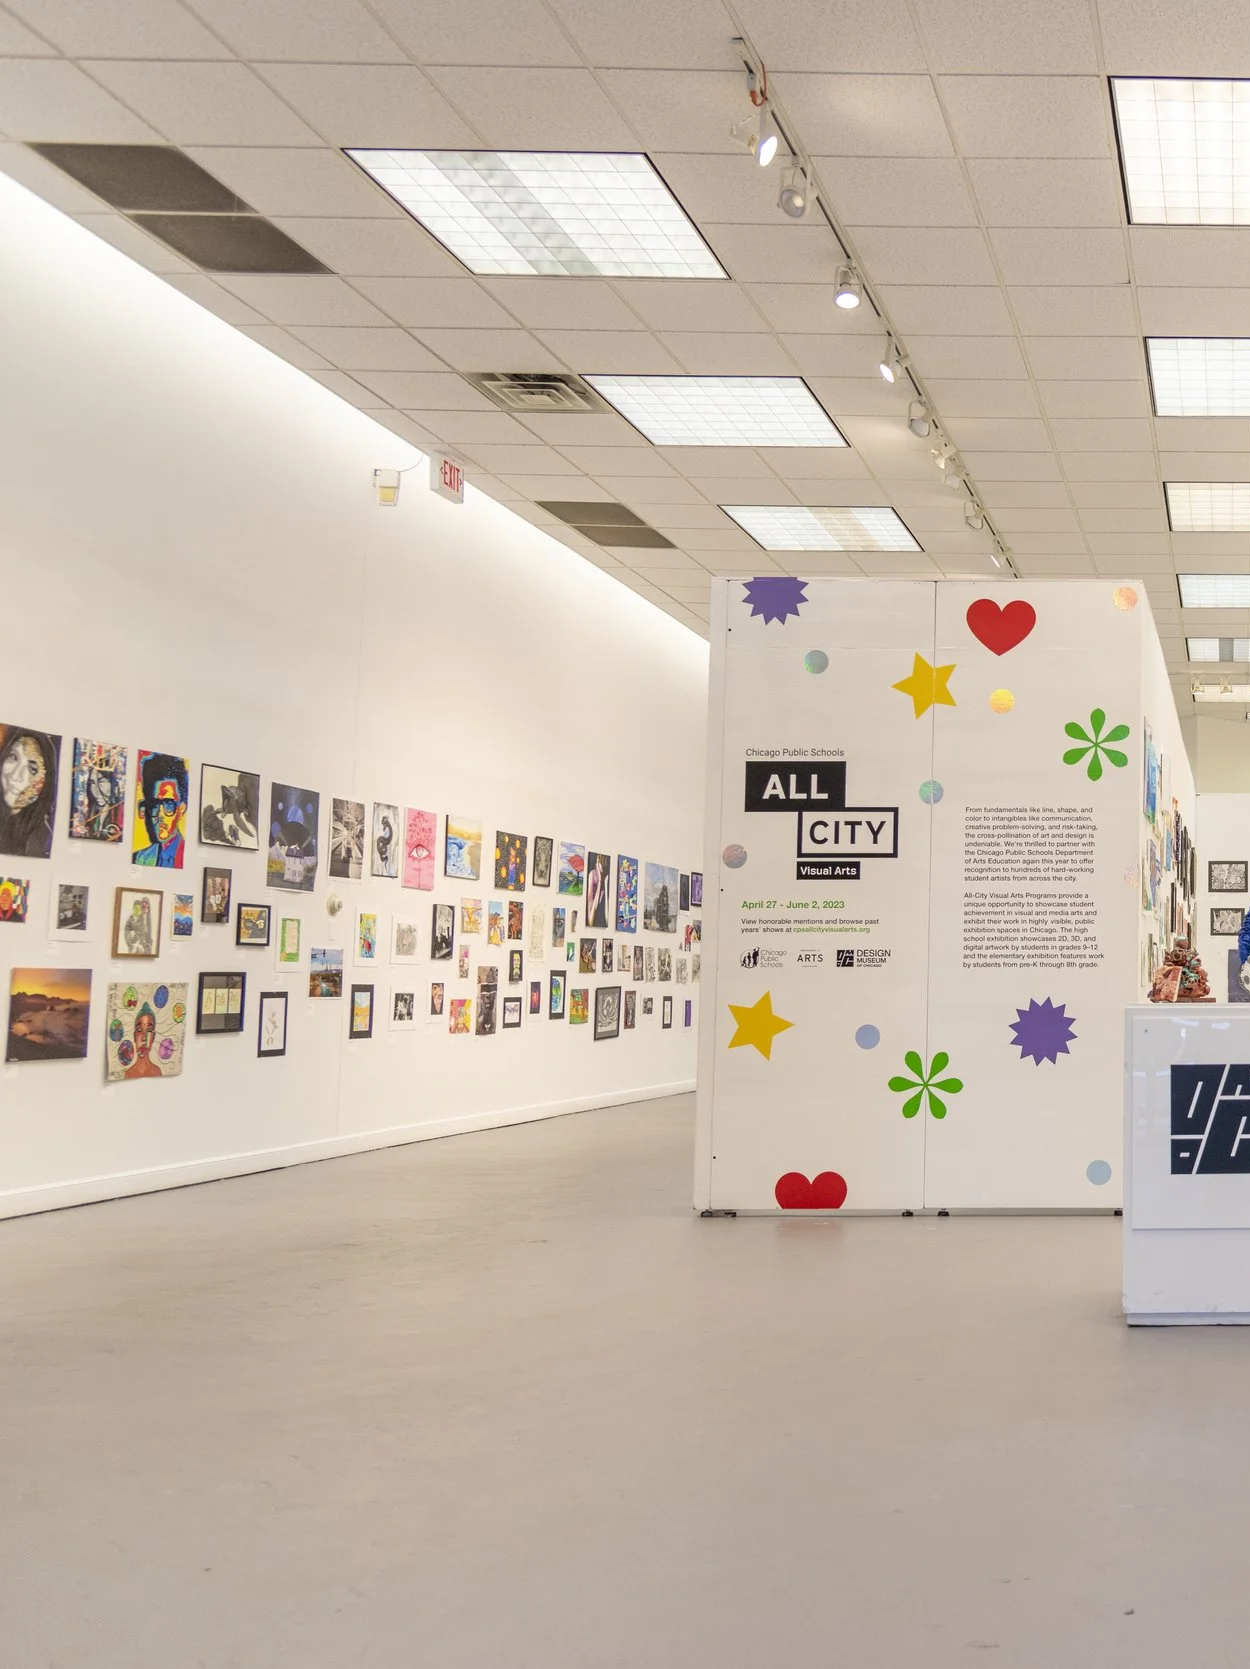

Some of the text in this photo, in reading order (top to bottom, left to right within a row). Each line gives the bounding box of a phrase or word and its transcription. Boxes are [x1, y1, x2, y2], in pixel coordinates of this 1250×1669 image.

[443, 460, 460, 493] EXIT
[745, 747, 844, 759] Chicago Public Schools
[762, 773, 828, 799] ALL
[984, 806, 1028, 814] fundamentals
[1029, 806, 1040, 814] like
[992, 815, 1027, 824] intangibles
[1041, 815, 1093, 823] communication,
[1048, 823, 1060, 831] and
[1062, 823, 1098, 832] risk-taking,
[809, 820, 886, 845] CITY
[977, 832, 1031, 840] cross-pollination
[1065, 832, 1087, 841] design
[965, 840, 1002, 848] undeniable.
[1024, 840, 1046, 848] thrilled
[1057, 841, 1080, 849] partner
[1082, 840, 1095, 848] with
[977, 848, 1004, 858] Chicago
[1006, 848, 1026, 856] Public
[1027, 848, 1054, 856] Schools
[1055, 849, 1093, 857] Department
[965, 857, 971, 865] of
[973, 857, 986, 865] Arts
[988, 857, 1020, 865] Education
[1022, 858, 1040, 866] again
[1042, 857, 1053, 865] this
[1055, 858, 1069, 866] year
[1079, 857, 1094, 865] offer
[799, 866, 857, 877] Visual Arts
[964, 866, 1001, 875] recognition
[1051, 866, 1094, 875] hard-working
[991, 874, 1011, 882] artists
[1012, 874, 1027, 882] from
[1064, 875, 1077, 883] city.
[964, 891, 988, 901] All-City
[989, 891, 1009, 899] Visual
[1026, 891, 1057, 901] Programs
[1058, 892, 1083, 900] provide
[741, 900, 764, 911] April
[766, 900, 777, 909] 27
[786, 900, 810, 909] June
[812, 900, 820, 910] 2,
[823, 900, 845, 909] 2023
[964, 900, 986, 909] unique
[988, 901, 1025, 909] opportunity
[1035, 900, 1068, 908] showcase
[1070, 900, 1094, 908] student
[964, 909, 1097, 917] achievement in visual and media arts and
[740, 918, 757, 926] View
[758, 918, 792, 926] honorable
[864, 918, 879, 926] past
[964, 917, 985, 925] exhibit
[987, 917, 1002, 925] their
[1029, 917, 1048, 927] highly
[1075, 918, 1095, 926] public
[964, 926, 995, 934] exhibition
[1022, 926, 1028, 934] in
[1060, 926, 1072, 934] The
[1074, 926, 1088, 935] high
[963, 935, 985, 943] school
[1020, 935, 1056, 943] showcases
[963, 943, 983, 953] digital
[985, 943, 1009, 951] artwork
[1011, 943, 1019, 952] by
[1021, 943, 1049, 951] students
[1051, 943, 1057, 951] in
[1058, 943, 1081, 952] grades
[963, 952, 1104, 961] and the elementary exhibition features work
[963, 961, 971, 970] by
[1020, 961, 1037, 969] pre-K
[1040, 961, 1064, 970] through
[1066, 960, 1077, 968] 8th
[1078, 961, 1099, 970] grade.
